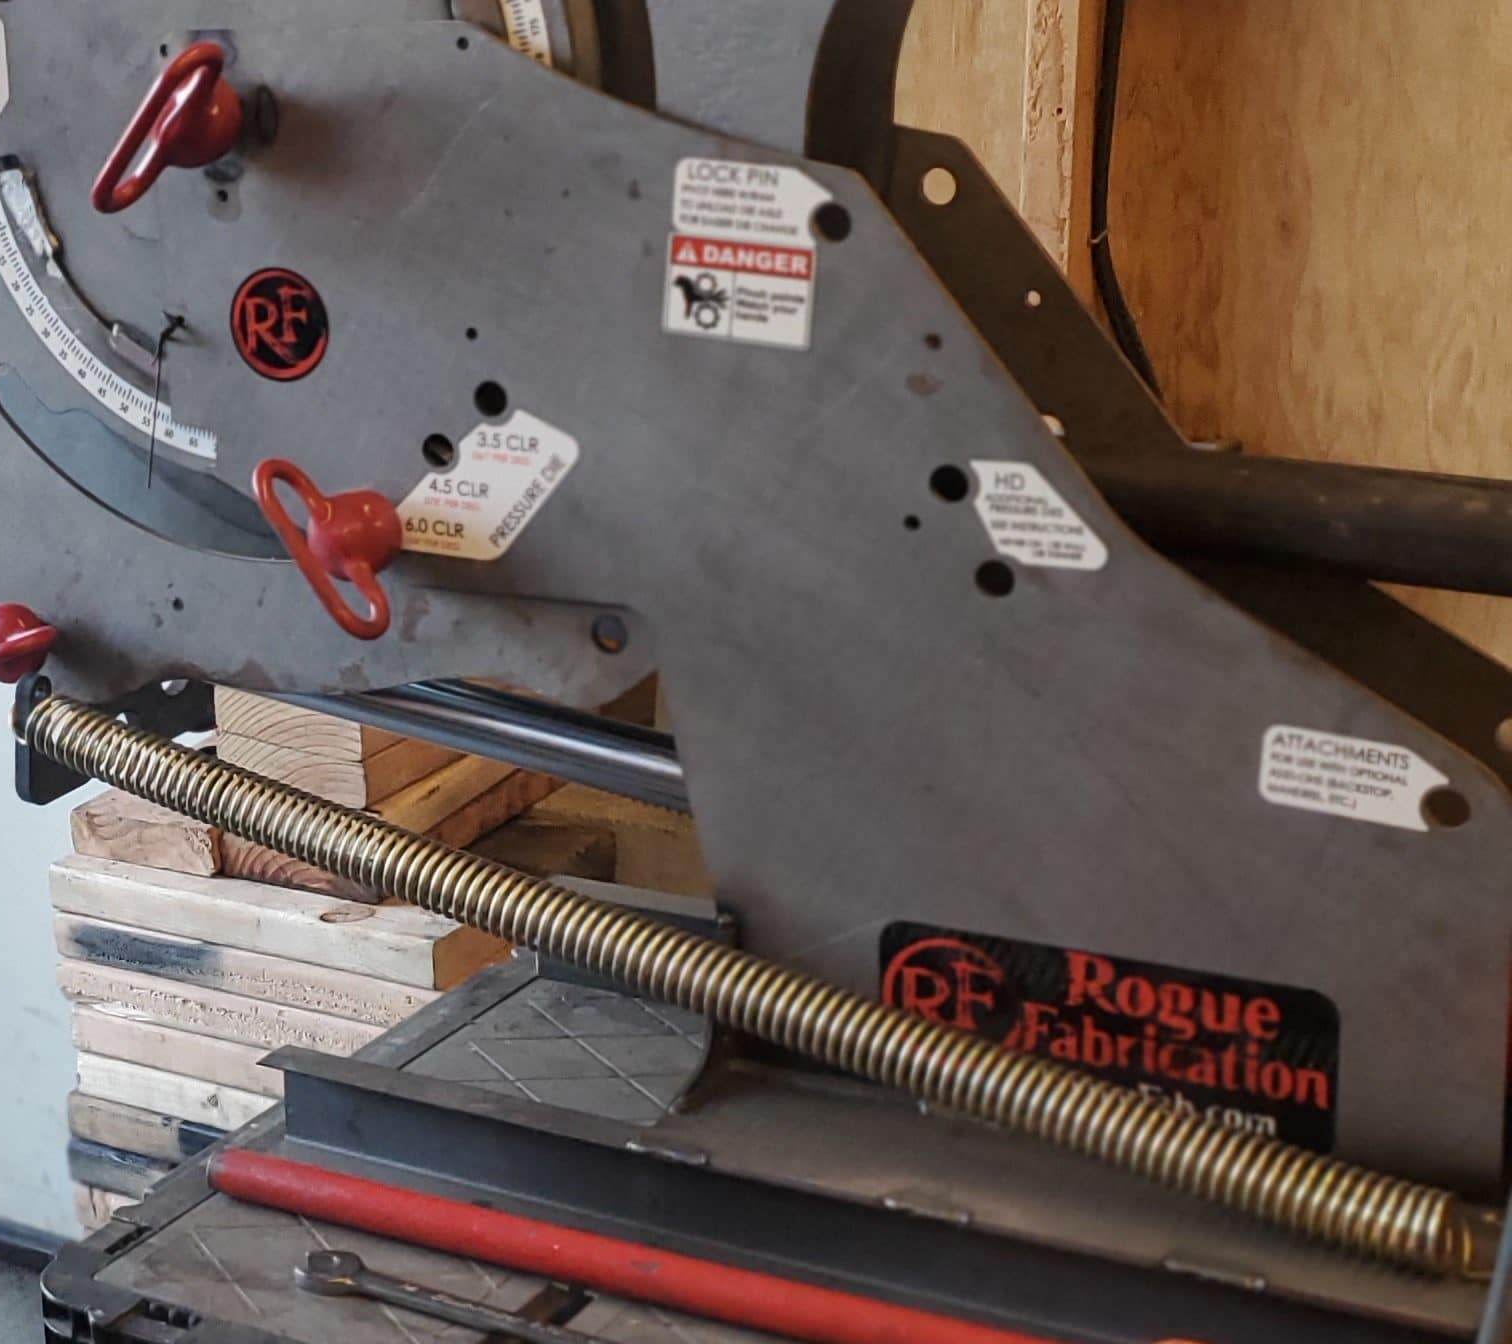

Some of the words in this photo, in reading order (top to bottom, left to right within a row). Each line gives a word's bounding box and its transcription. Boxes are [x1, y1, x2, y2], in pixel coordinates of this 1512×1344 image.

[687, 163, 738, 183] LOCK
[746, 167, 779, 186] PIN
[702, 244, 809, 275] DANGER
[245, 284, 313, 364] RF
[11, 280, 21, 293] 20
[25, 304, 36, 318] 25
[41, 327, 51, 340] 30
[59, 348, 68, 361] 35
[77, 368, 87, 380] 40
[97, 387, 107, 399] 45
[119, 402, 129, 414] 50
[141, 416, 151, 428] 55
[164, 428, 175, 439] 60
[189, 436, 199, 448] 65
[476, 431, 502, 449] 3.5
[506, 434, 539, 454] CLR
[429, 479, 453, 495] 4.5
[456, 480, 490, 498] CLR
[995, 472, 1026, 491] HD
[405, 517, 429, 534] 6.0
[432, 519, 465, 539] CLR
[488, 478, 547, 548] PRESSURE
[1272, 732, 1410, 771] ATTACHMENTS
[1065, 948, 1282, 1041] Rogue
[1022, 1001, 1330, 1110] Fabrication
